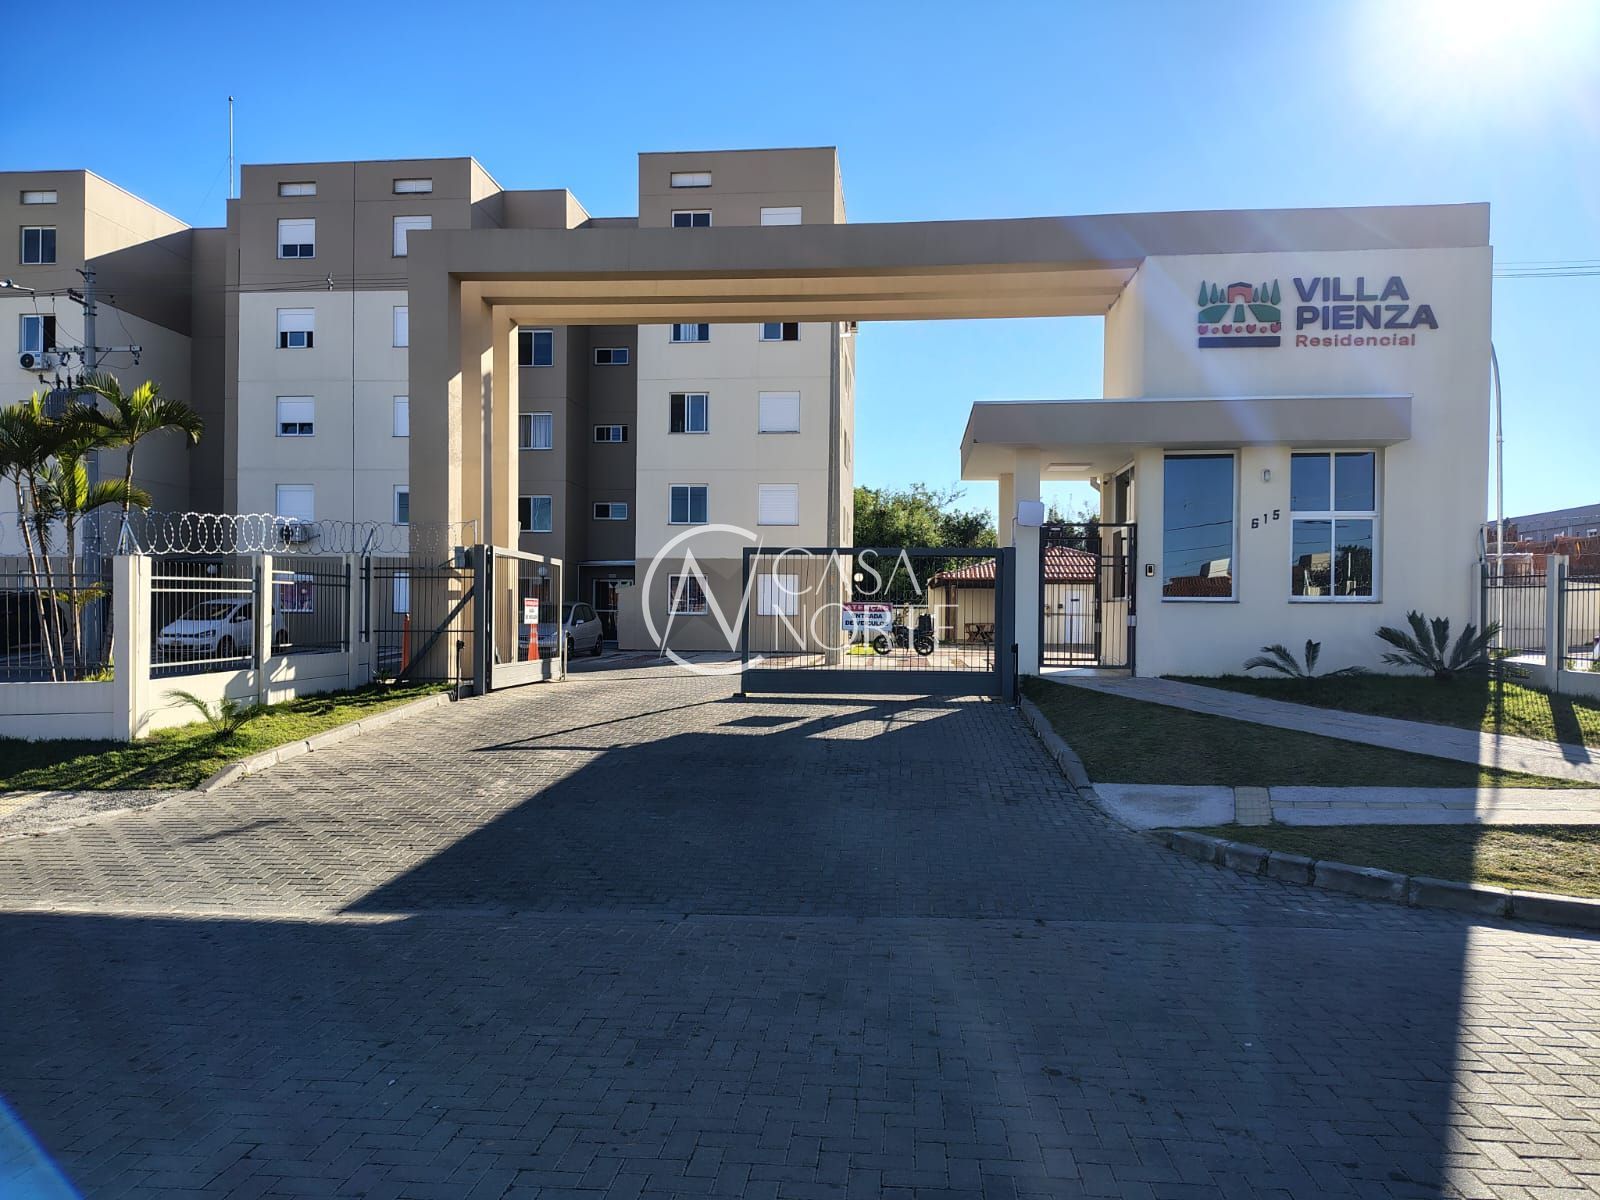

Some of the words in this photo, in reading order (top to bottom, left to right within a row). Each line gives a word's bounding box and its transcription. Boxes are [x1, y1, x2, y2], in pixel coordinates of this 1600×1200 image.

[1293, 276, 1410, 302] VILLA
[1296, 304, 1439, 331] PIENZA
[1296, 333, 1416, 347] Residencial
[1251, 509, 1280, 529] 615
